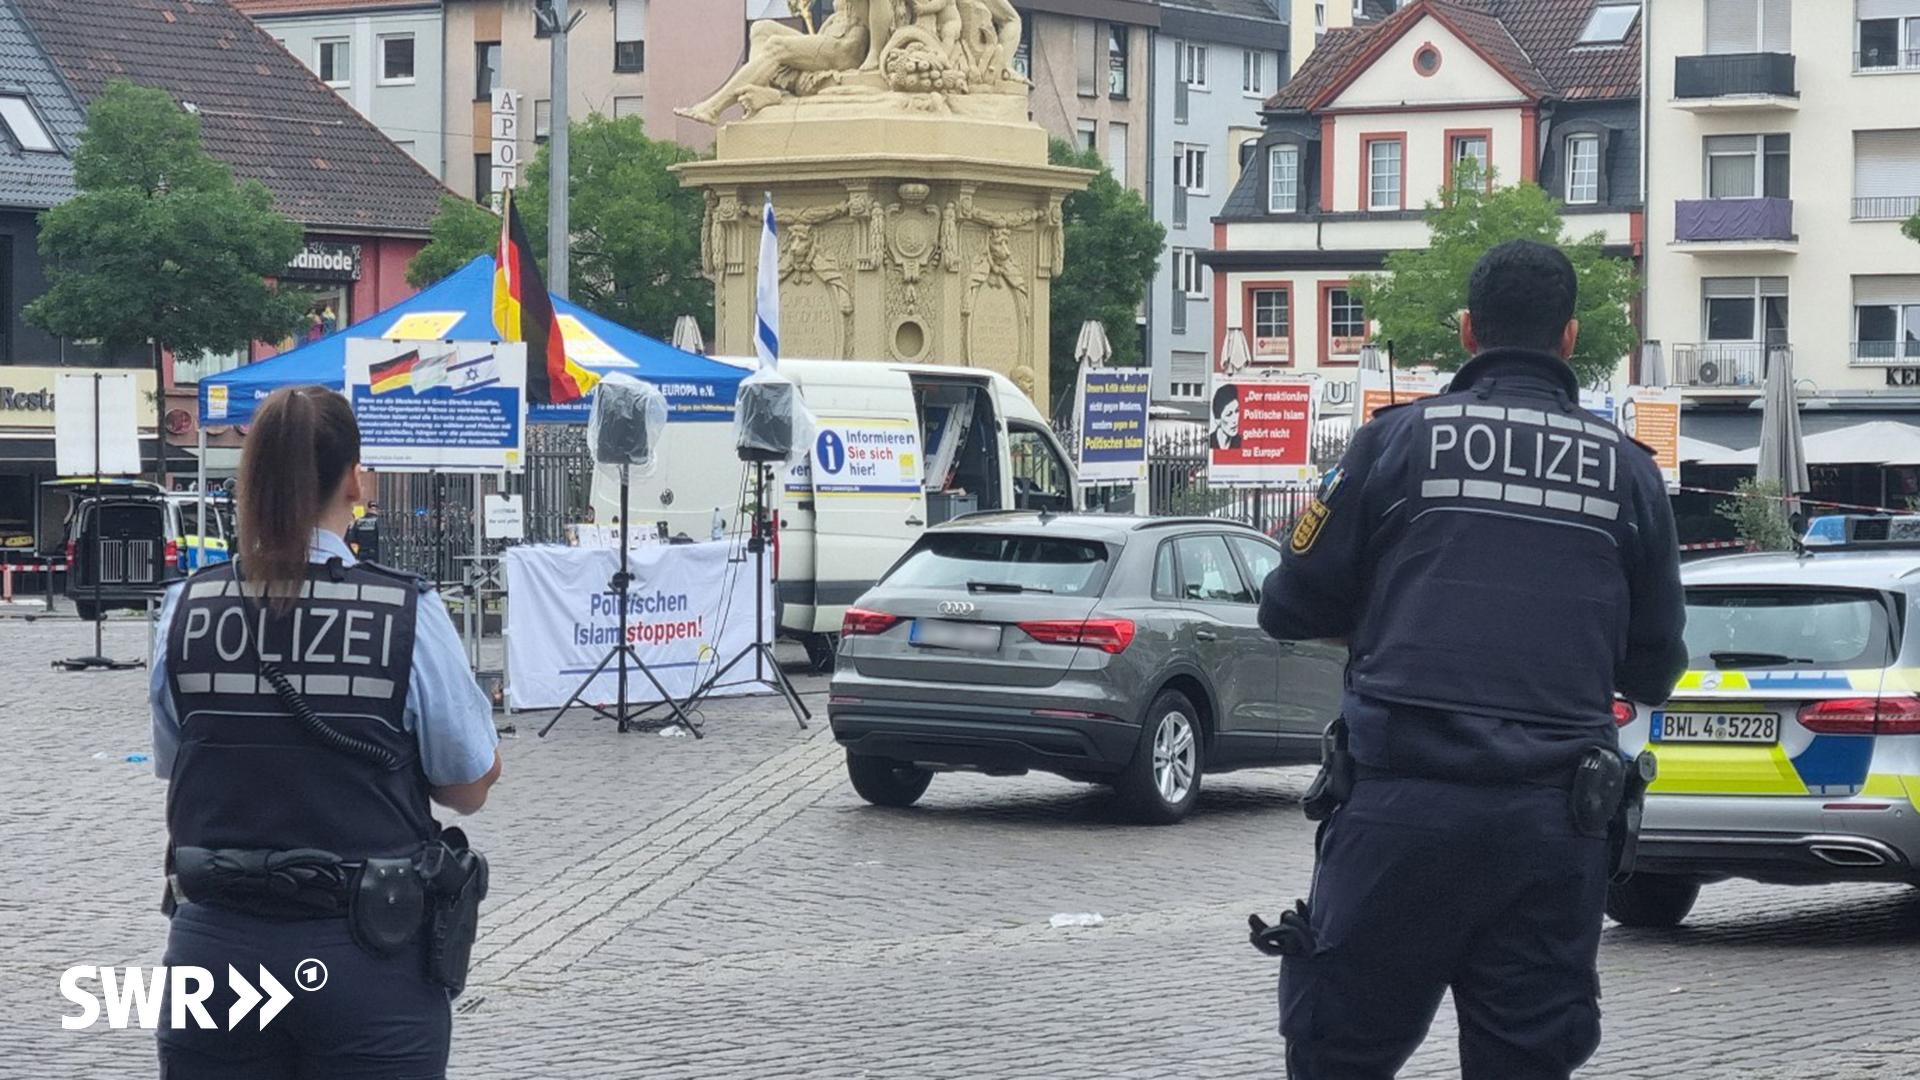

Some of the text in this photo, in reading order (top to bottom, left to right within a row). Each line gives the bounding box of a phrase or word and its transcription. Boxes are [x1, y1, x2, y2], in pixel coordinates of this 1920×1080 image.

[1886, 367, 1920, 386] KE
[661, 383, 698, 397] EUROPA
[699, 384, 716, 397] e.V.
[1244, 409, 1305, 420] Politische Islam
[846, 430, 916, 445] Informieren
[1242, 427, 1291, 441] gehört nicht
[1085, 436, 1143, 450] Politischen Islam
[848, 446, 894, 460] Sie sich
[1242, 448, 1252, 458] zu
[1430, 424, 1616, 492] POLIZEI
[850, 463, 876, 477] hier!
[183, 606, 393, 667] POLIZEI
[574, 615, 703, 646] Islam stoppen!
[1664, 716, 1774, 738] BWL 4 5228
